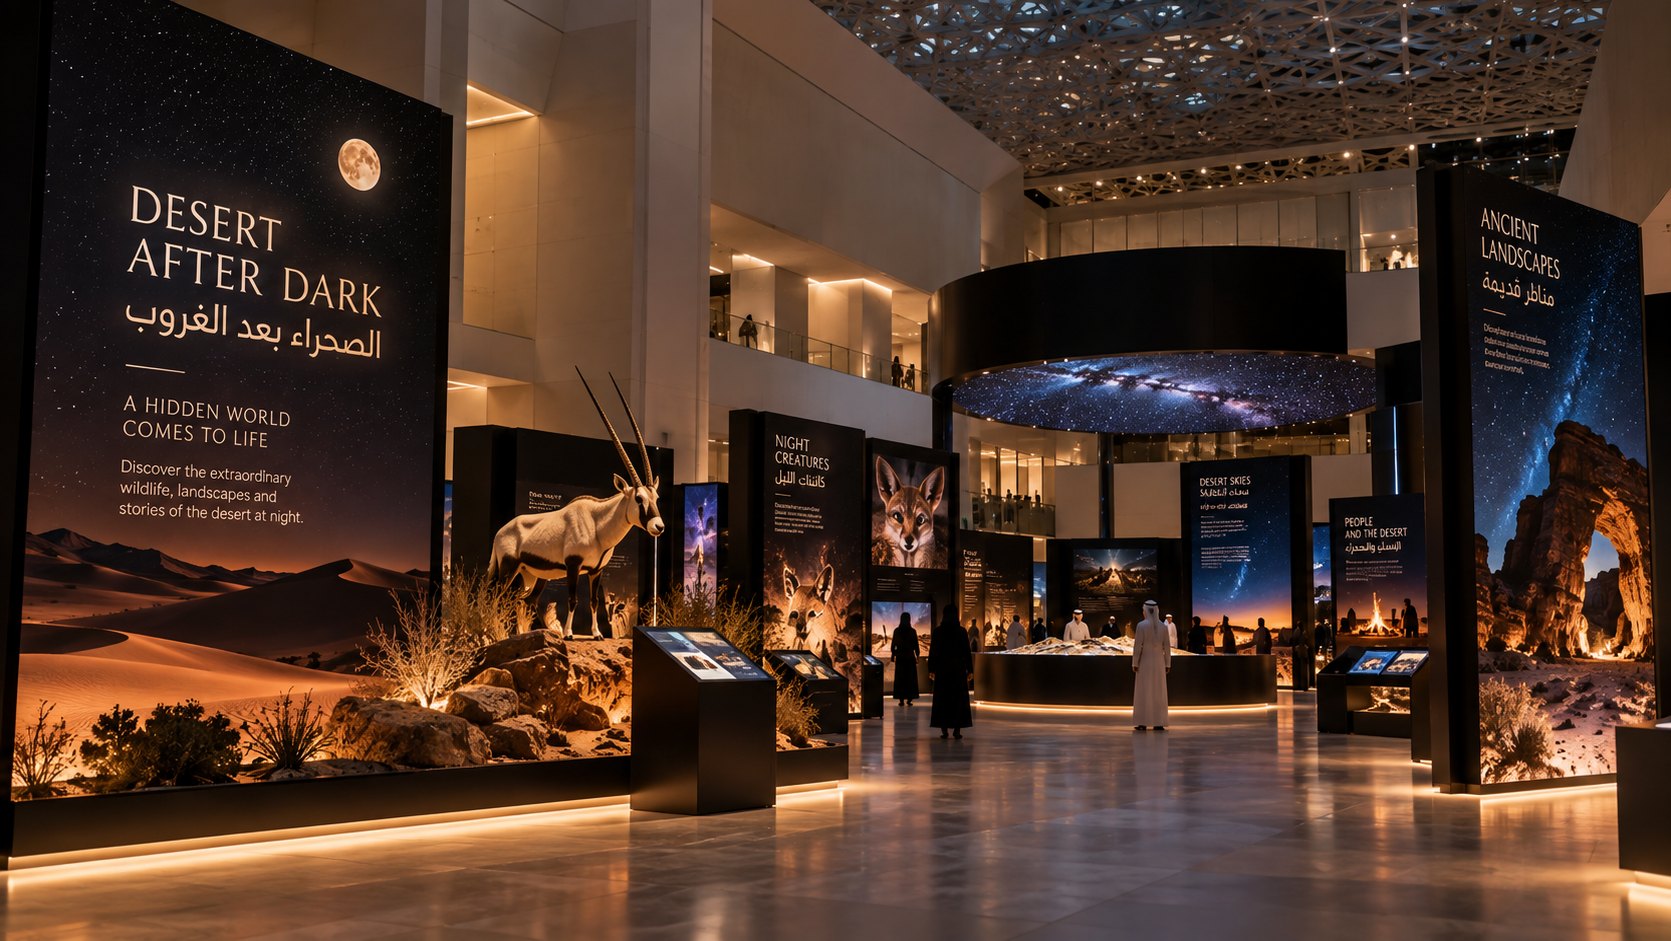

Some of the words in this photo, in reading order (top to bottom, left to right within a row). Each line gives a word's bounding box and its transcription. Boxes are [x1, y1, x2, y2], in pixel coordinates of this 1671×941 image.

[130, 185, 282, 252] DESERT
[1480, 207, 1540, 245] ANCIENT
[1481, 236, 1562, 280] LANDSCAPES
[126, 238, 263, 297] AFTER
[283, 267, 382, 318] DARK
[1482, 270, 1522, 300] قديمة
[1524, 282, 1556, 308] مناظر
[125, 303, 228, 339] الغروب
[237, 319, 282, 352] بعد
[290, 318, 381, 359] الصحراء
[123, 394, 137, 412] A
[145, 396, 219, 420] HIDDEN
[226, 405, 291, 427] WORLD
[122, 419, 194, 442] COMES
[201, 426, 226, 445] TO
[233, 430, 268, 448] LIFE
[775, 434, 810, 452] NIGHT
[121, 459, 181, 477] Discover
[184, 464, 207, 479] the
[210, 468, 292, 488] extraordinary
[774, 450, 830, 472] CREATURES
[120, 481, 174, 499] wildlife,
[177, 484, 251, 503] landscapes
[254, 488, 277, 503] and
[1230, 475, 1252, 486] SKIES
[119, 502, 165, 517] stories
[169, 504, 183, 518] of
[186, 505, 208, 519] the
[211, 507, 251, 521] desert
[254, 509, 267, 522] at
[270, 510, 304, 526] night.
[1344, 516, 1374, 527] PEOPLE
[1344, 529, 1362, 539] AND
[1364, 528, 1378, 538] THE
[1379, 527, 1408, 538] DESERT
